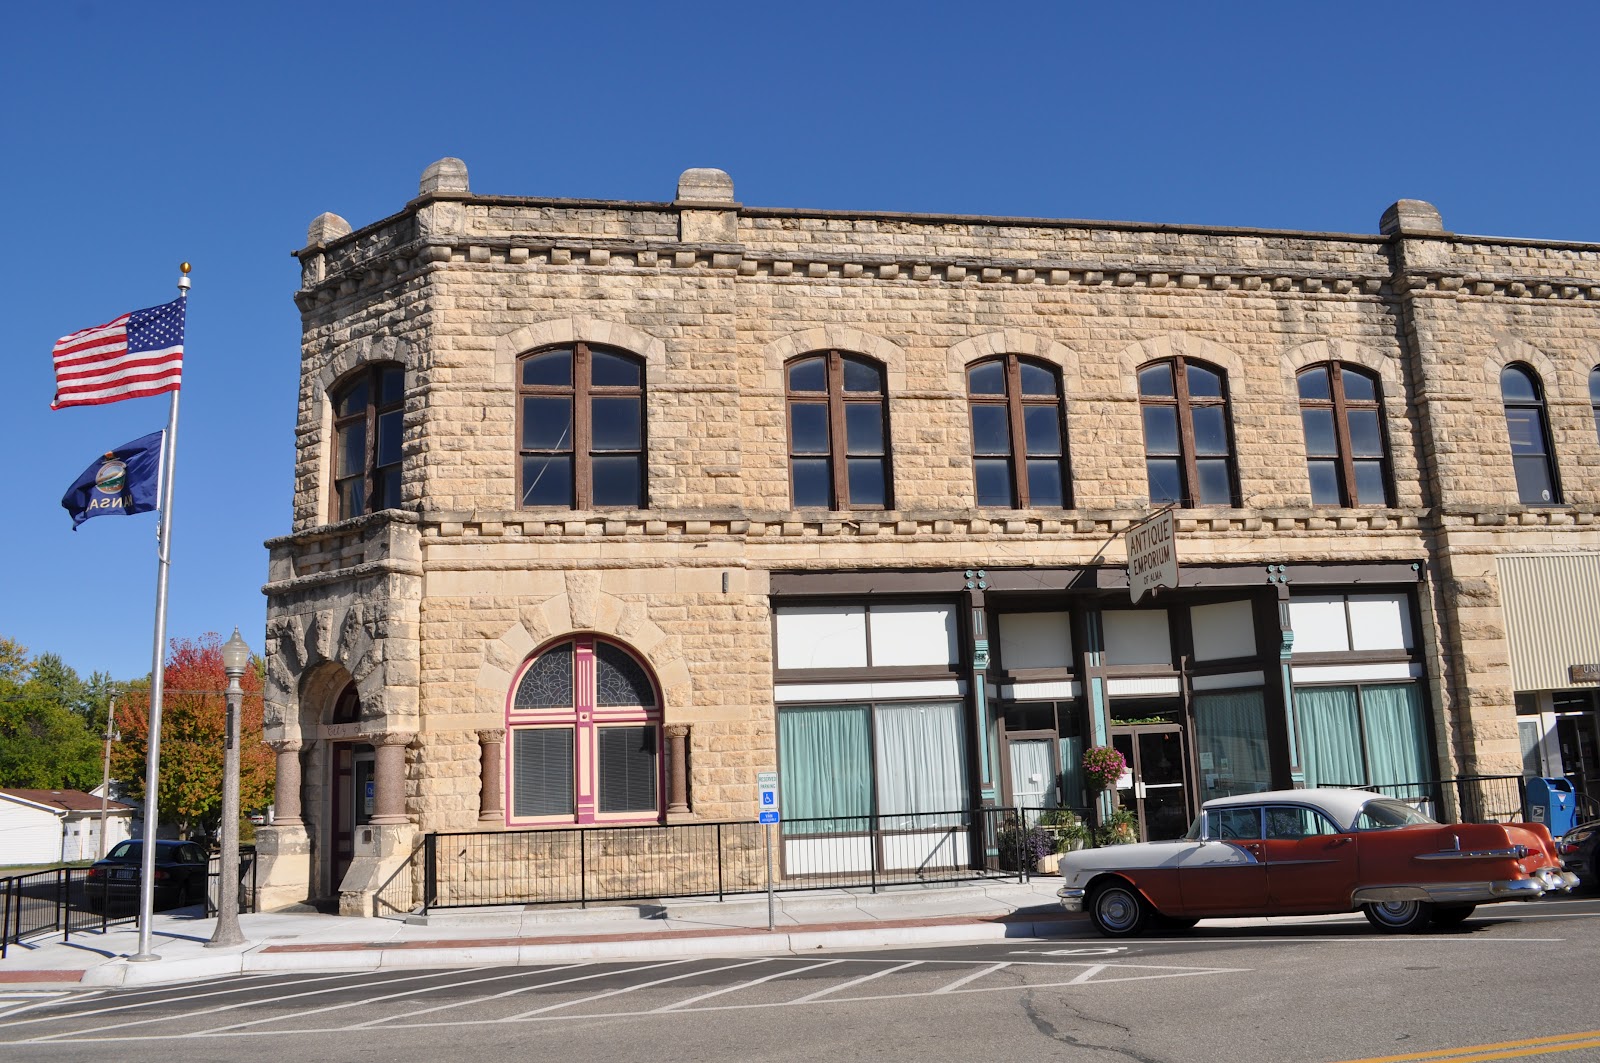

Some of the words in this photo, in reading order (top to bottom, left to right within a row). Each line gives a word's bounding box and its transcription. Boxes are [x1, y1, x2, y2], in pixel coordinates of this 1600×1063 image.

[1131, 518, 1170, 556] ANTIQUE
[1133, 545, 1171, 575] EMPORIUM
[1144, 575, 1149, 585] OF
[1150, 571, 1162, 582] ALMA
